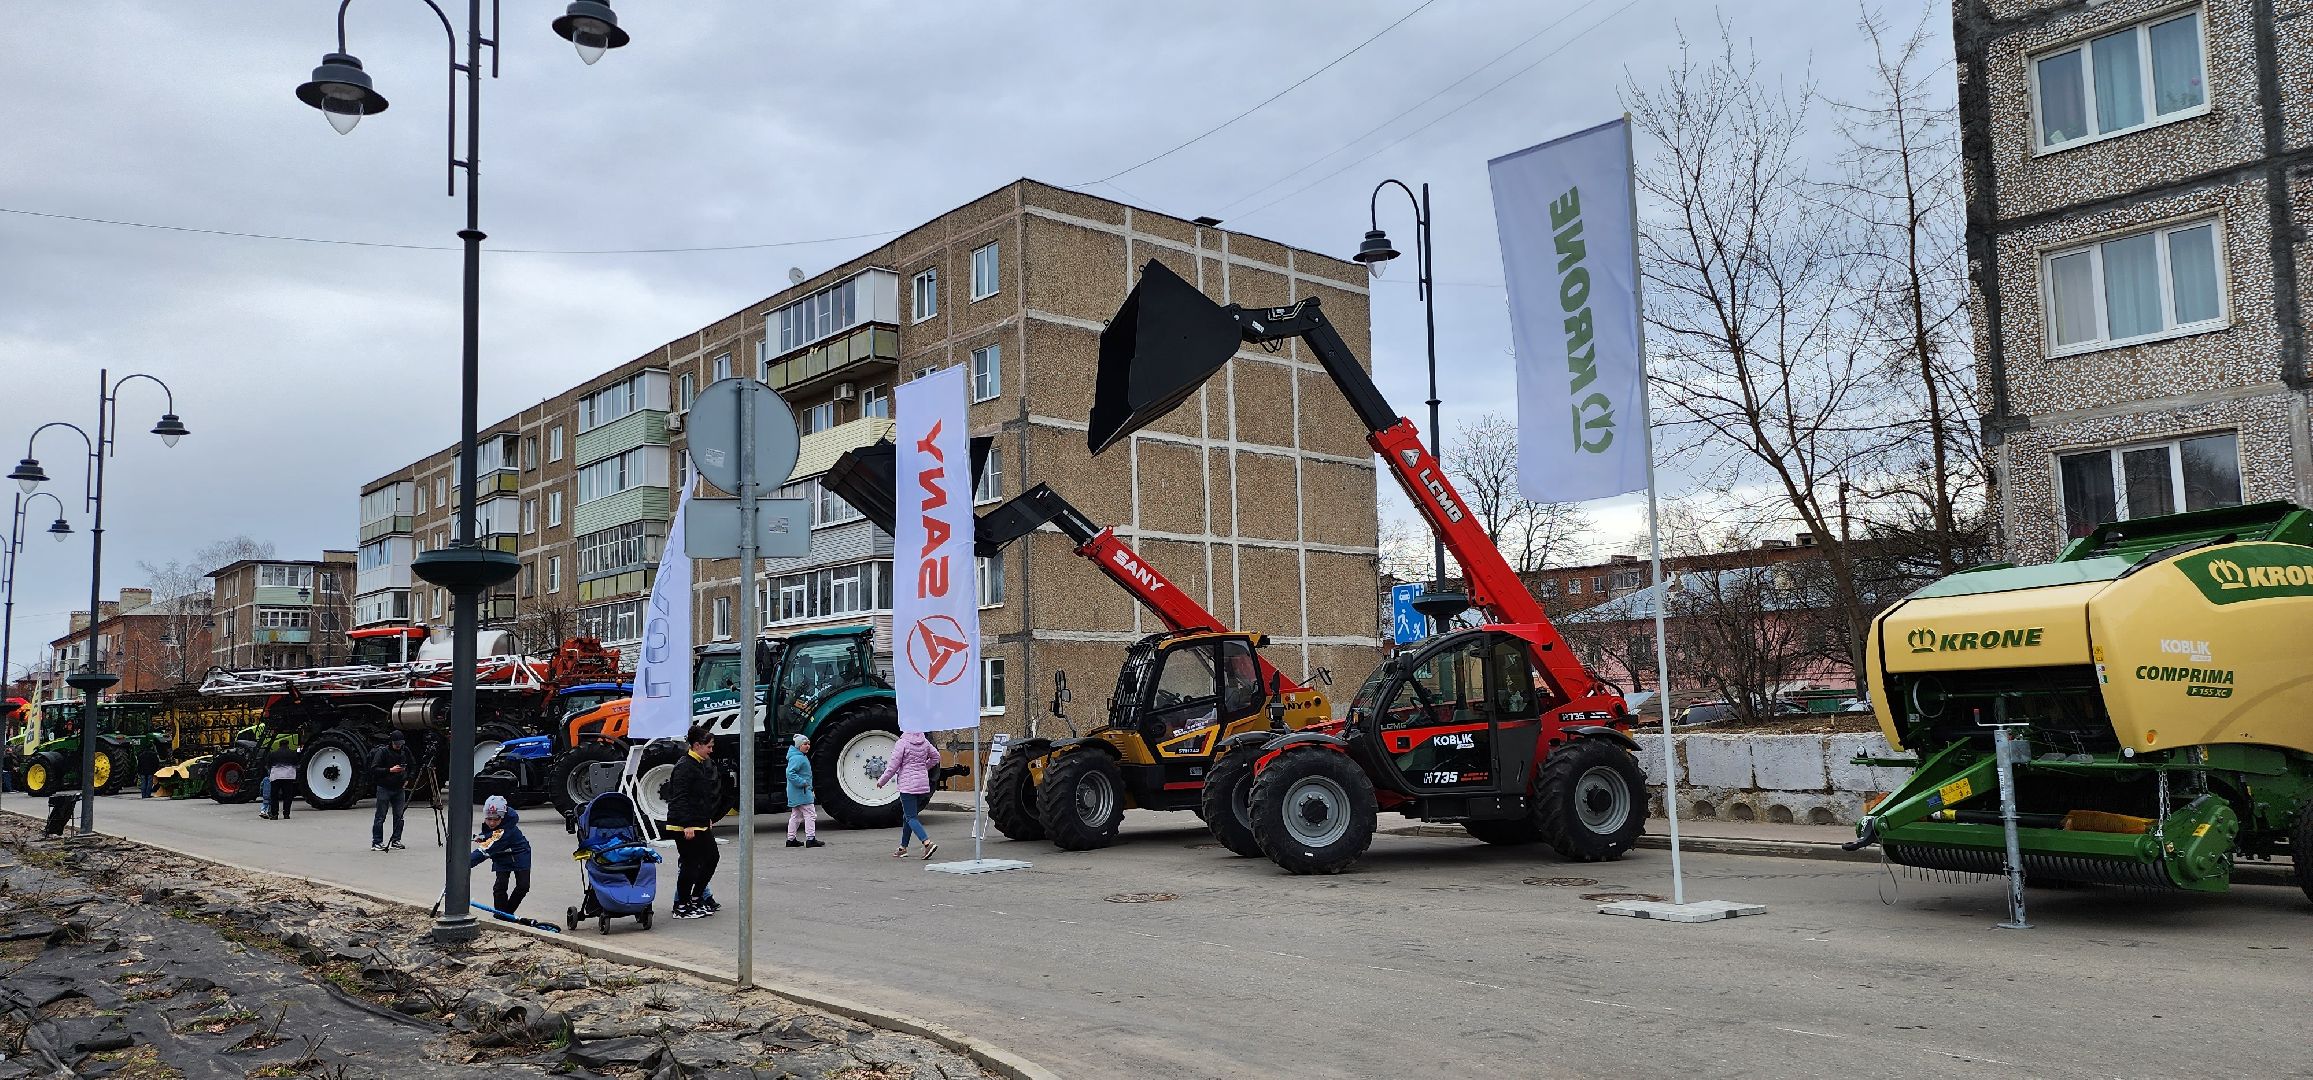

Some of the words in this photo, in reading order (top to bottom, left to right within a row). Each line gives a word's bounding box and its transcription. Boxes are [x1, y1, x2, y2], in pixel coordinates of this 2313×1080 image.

[1418, 467, 1464, 524] LGMG
[1112, 549, 1165, 592] SANY
[1939, 627, 2045, 652] KRONE
[2135, 665, 2234, 685] COMPRIMA
[2191, 687, 2198, 695] F
[2199, 688, 2215, 696] 155
[2215, 688, 2227, 697] XC
[703, 698, 737, 709] LOVOL
[1423, 771, 1459, 784] H735
